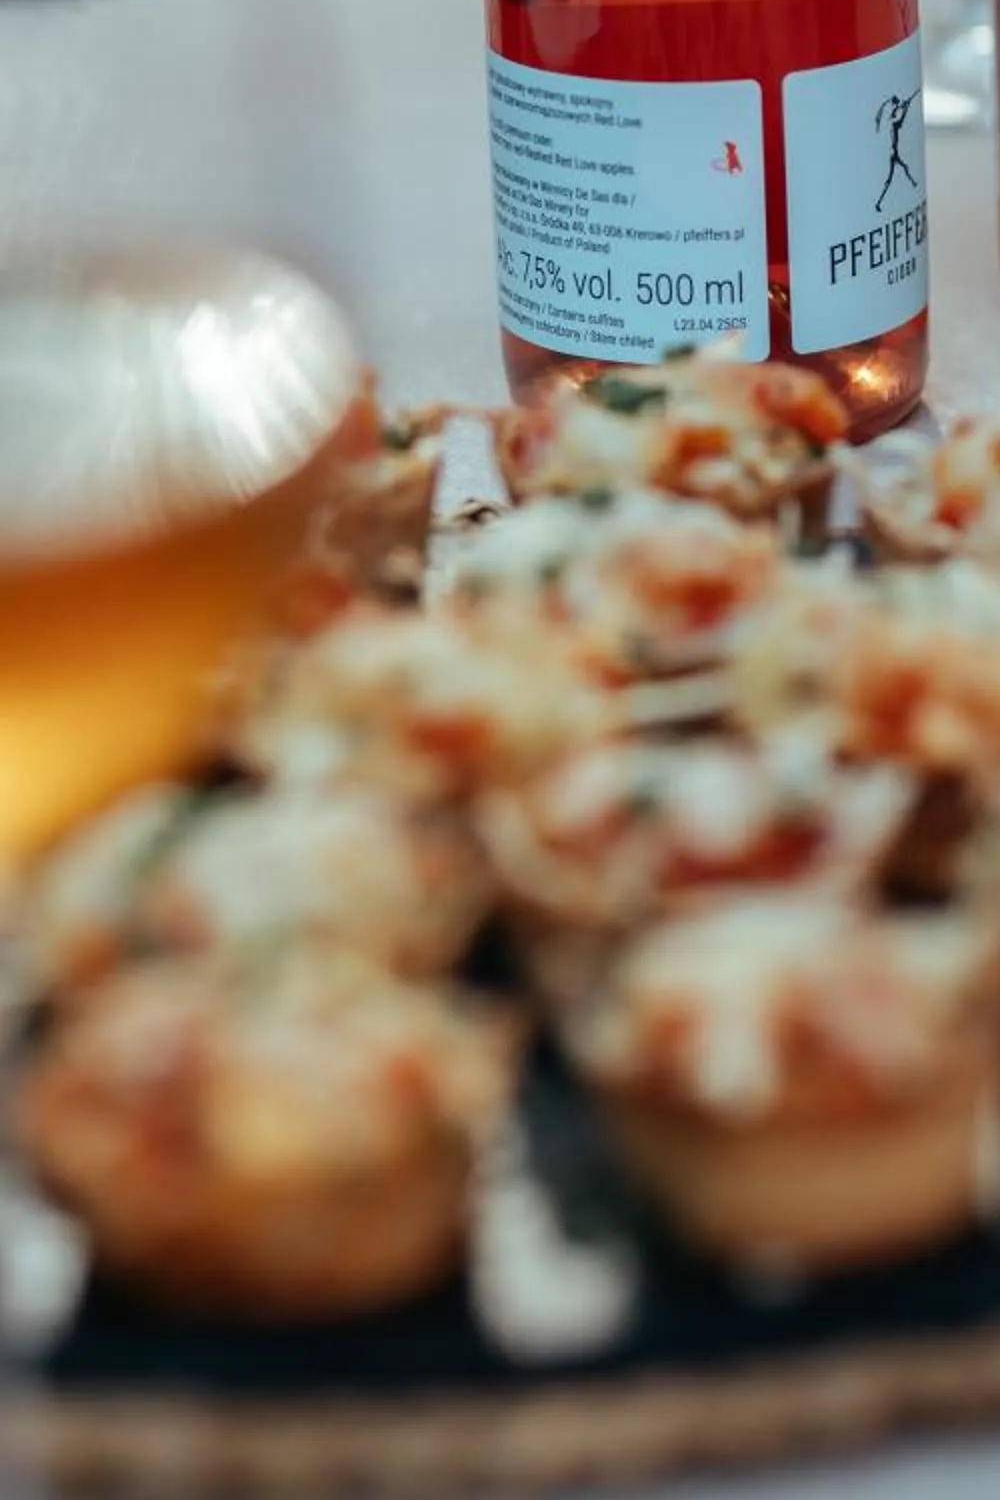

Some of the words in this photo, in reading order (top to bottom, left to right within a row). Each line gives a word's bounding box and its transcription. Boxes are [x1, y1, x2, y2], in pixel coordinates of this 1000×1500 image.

[520, 250, 566, 294] 7,5%
[572, 267, 622, 303] vol.
[636, 272, 695, 306] 500
[704, 269, 744, 305] ml
